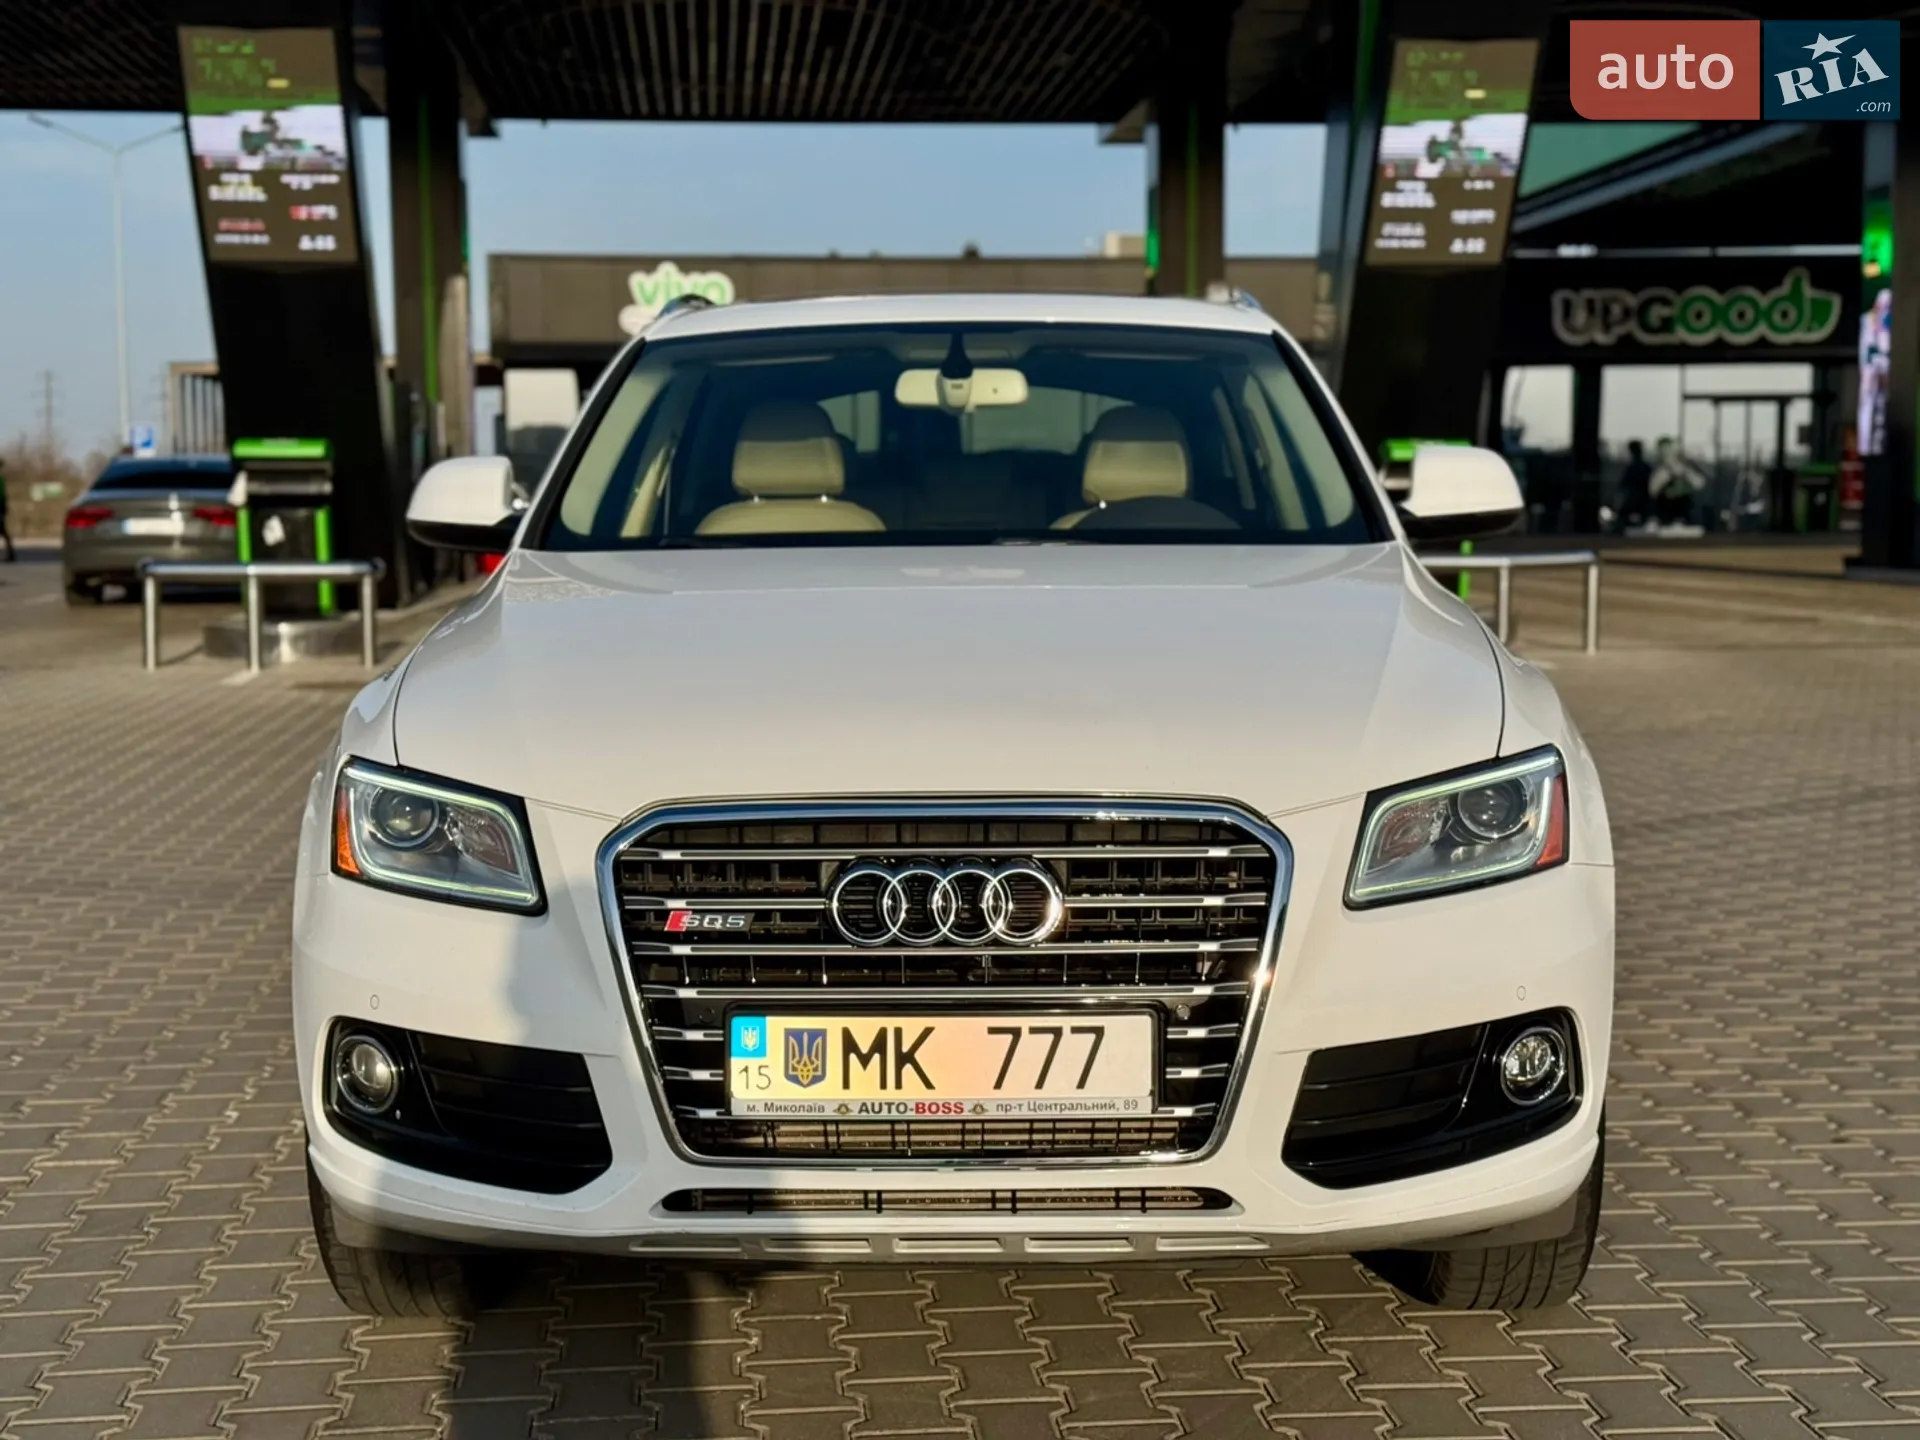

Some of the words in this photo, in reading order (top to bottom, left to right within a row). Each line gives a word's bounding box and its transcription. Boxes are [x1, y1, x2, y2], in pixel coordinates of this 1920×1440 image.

[841, 1026, 936, 1091] MK
[986, 1025, 1106, 1091] 777
[738, 1064, 772, 1090] 15
[764, 1101, 826, 1114] Миколаїв
[857, 1101, 965, 1115] AUTO-BOSS
[995, 1103, 1023, 1114] пр-т
[1026, 1099, 1121, 1113] Центральний,
[1123, 1098, 1139, 1111] 89
